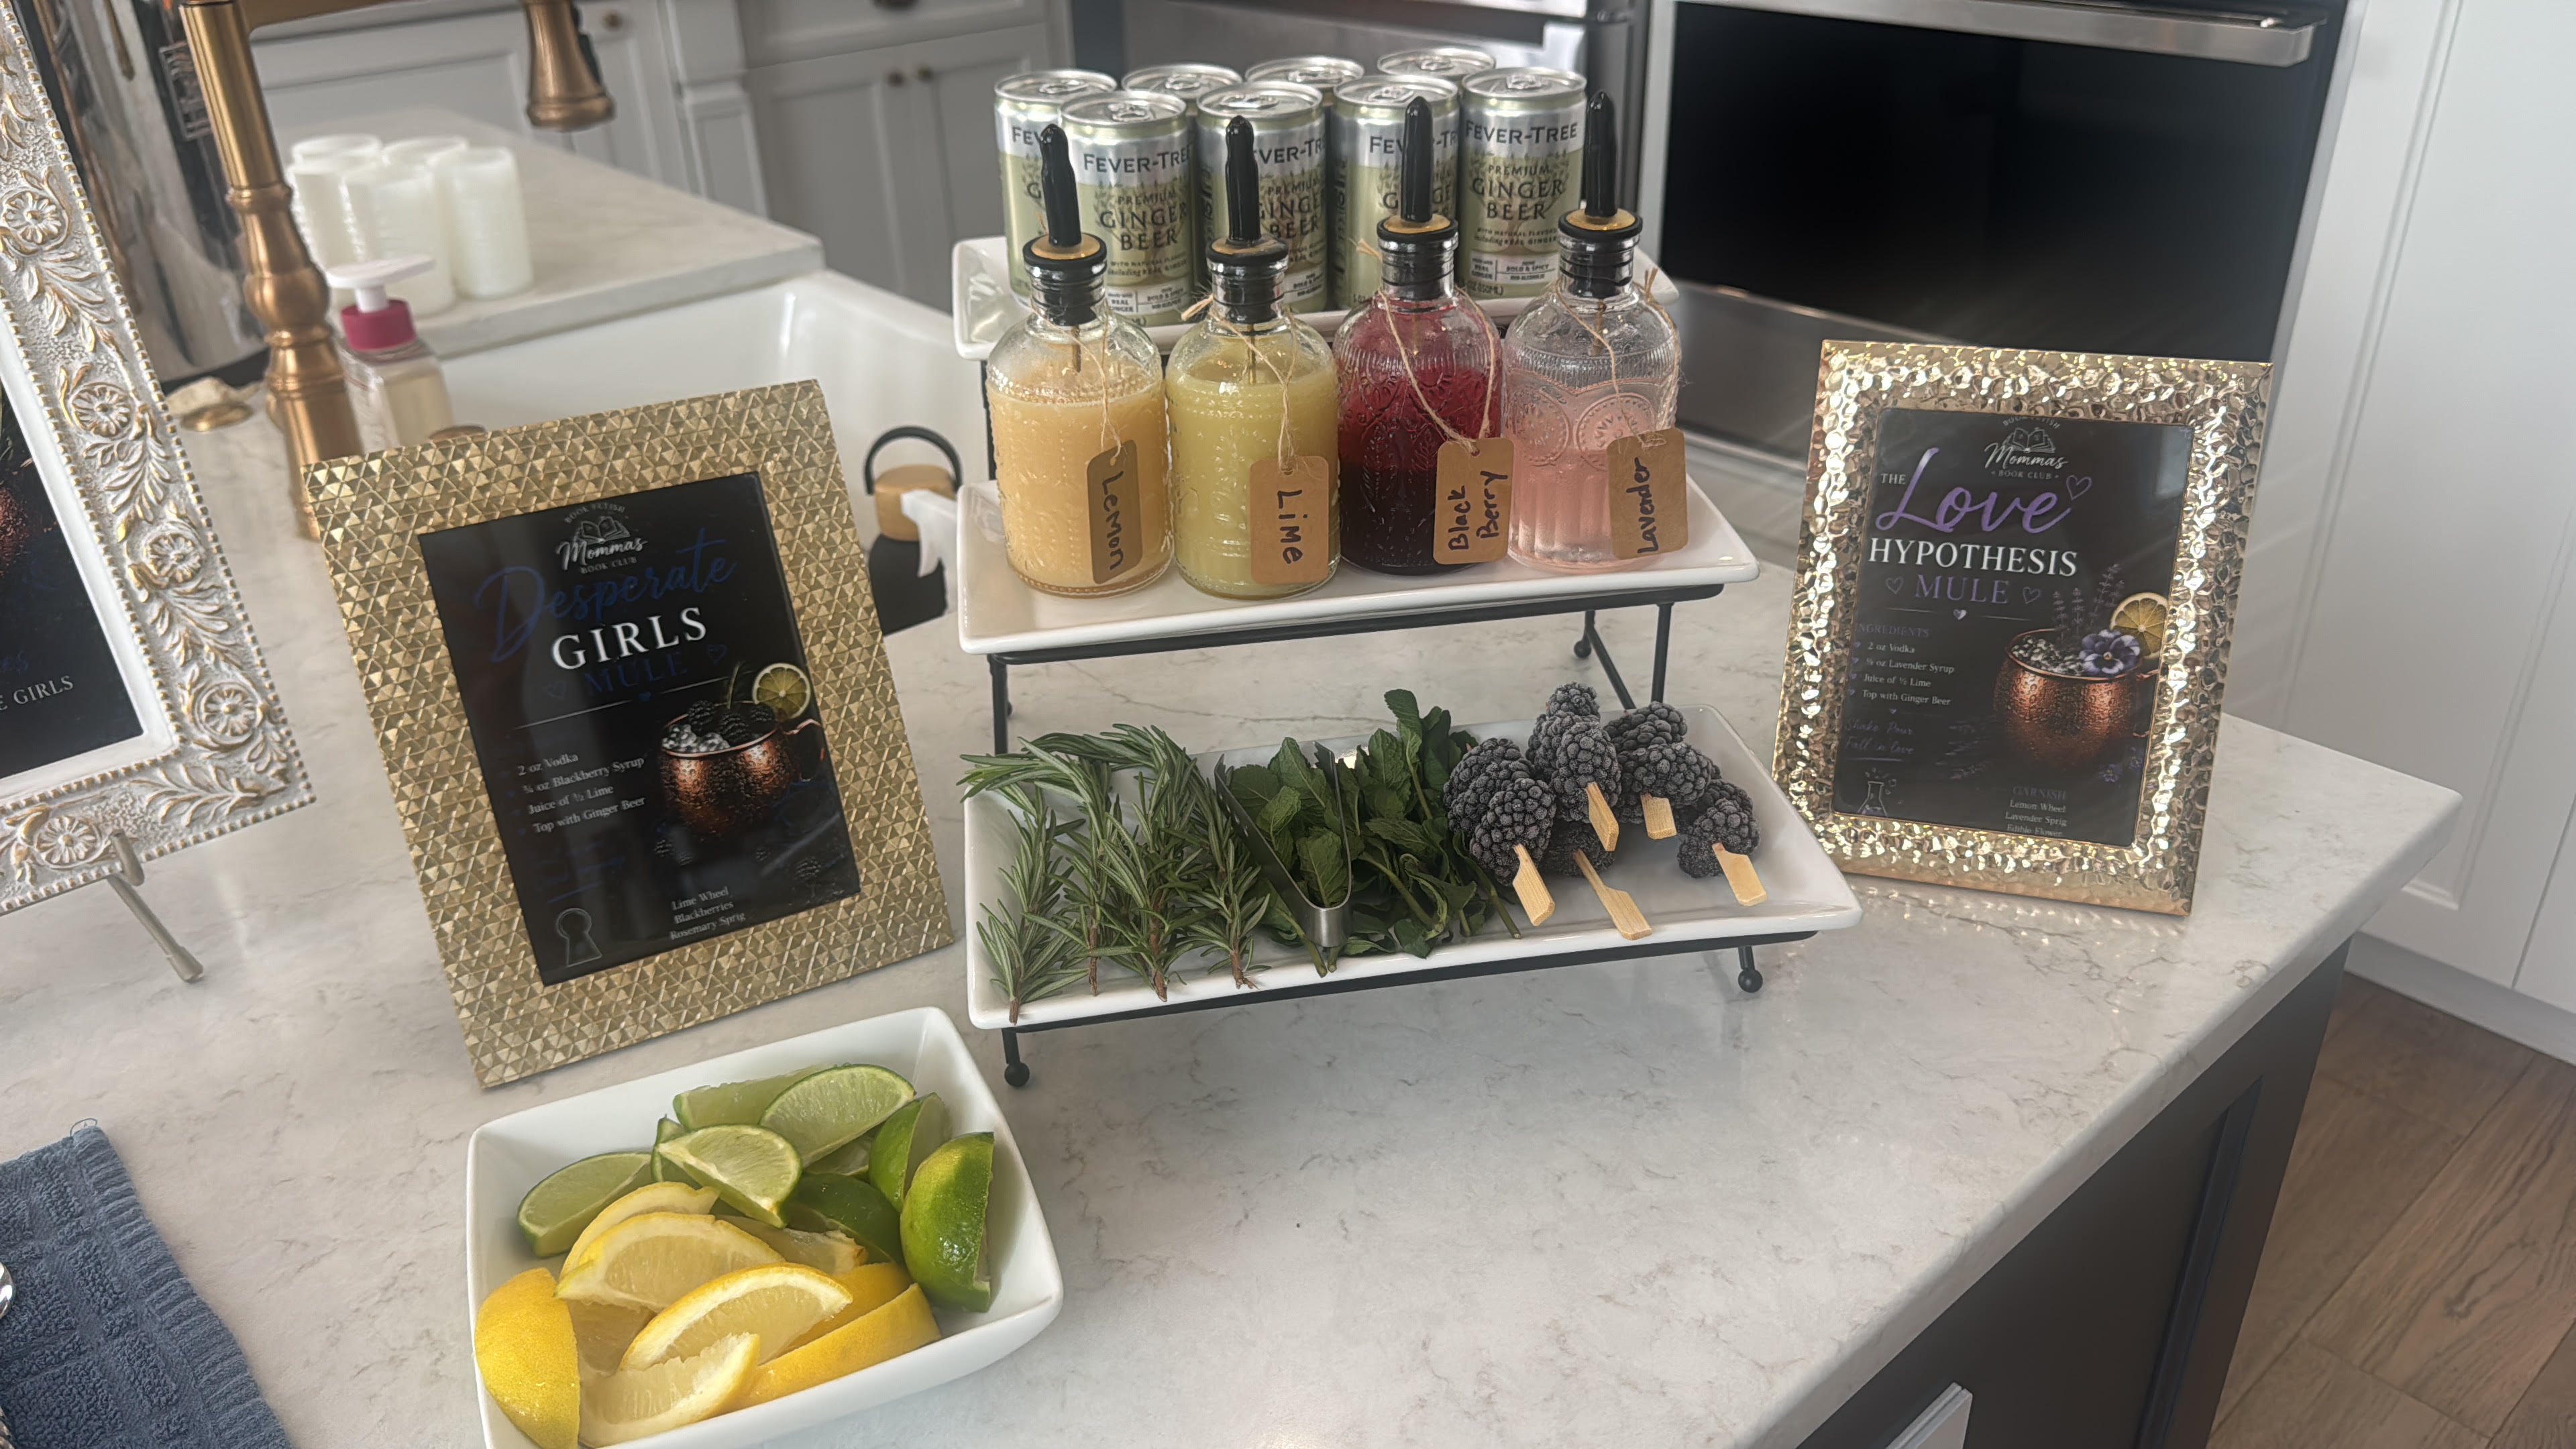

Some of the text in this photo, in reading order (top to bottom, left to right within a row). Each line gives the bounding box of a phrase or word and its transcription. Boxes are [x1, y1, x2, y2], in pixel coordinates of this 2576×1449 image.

[1466, 121, 1578, 144] FEVER-TREE
[1488, 163, 1550, 176] PREMIUM
[1472, 177, 1563, 199] GINGER
[1487, 202, 1546, 221] BEER
[1120, 228, 1178, 251] BEER
[1984, 441, 2068, 470] Mommas
[1880, 472, 1907, 486] THE
[2027, 471, 2051, 480] CLUB
[1876, 447, 2072, 535] Love
[1476, 470, 1509, 539] Berry
[1626, 456, 1659, 554] Lavender
[1447, 485, 1469, 551] Black
[555, 535, 649, 571] Mommas
[1868, 537, 2078, 577] HYPOTHESIS
[474, 527, 738, 663] Desperate
[1915, 574, 2011, 604] MULE
[551, 606, 707, 671] GIRLS
[1868, 641, 1874, 650] 2
[1889, 643, 1916, 653] Vodka
[584, 650, 689, 695] MULE
[1889, 659, 1927, 671] Lavender
[1929, 663, 1955, 675] Syrup
[13, 674, 74, 704] GIRLS
[1864, 673, 1884, 683] Juice
[1886, 676, 1896, 684] of
[1910, 678, 1932, 688] Lime
[1862, 689, 1952, 706] Top with Ginger Beer
[517, 753, 579, 776] 2 oz Vodka
[552, 766, 610, 788] Blackberry
[611, 757, 645, 773] Syrup
[528, 800, 556, 815] Juice
[558, 794, 570, 806] of
[586, 785, 614, 800] Lime
[2009, 799, 2067, 813] Lemon Wheel
[532, 797, 646, 834] Top with Ginger Beer
[2004, 811, 2068, 827] Lavender Sprig
[2007, 824, 2032, 834] Edible
[670, 886, 729, 911] Lime Wheel
[674, 901, 735, 925] Blackberries
[669, 912, 747, 941] Rosemary Sprig
